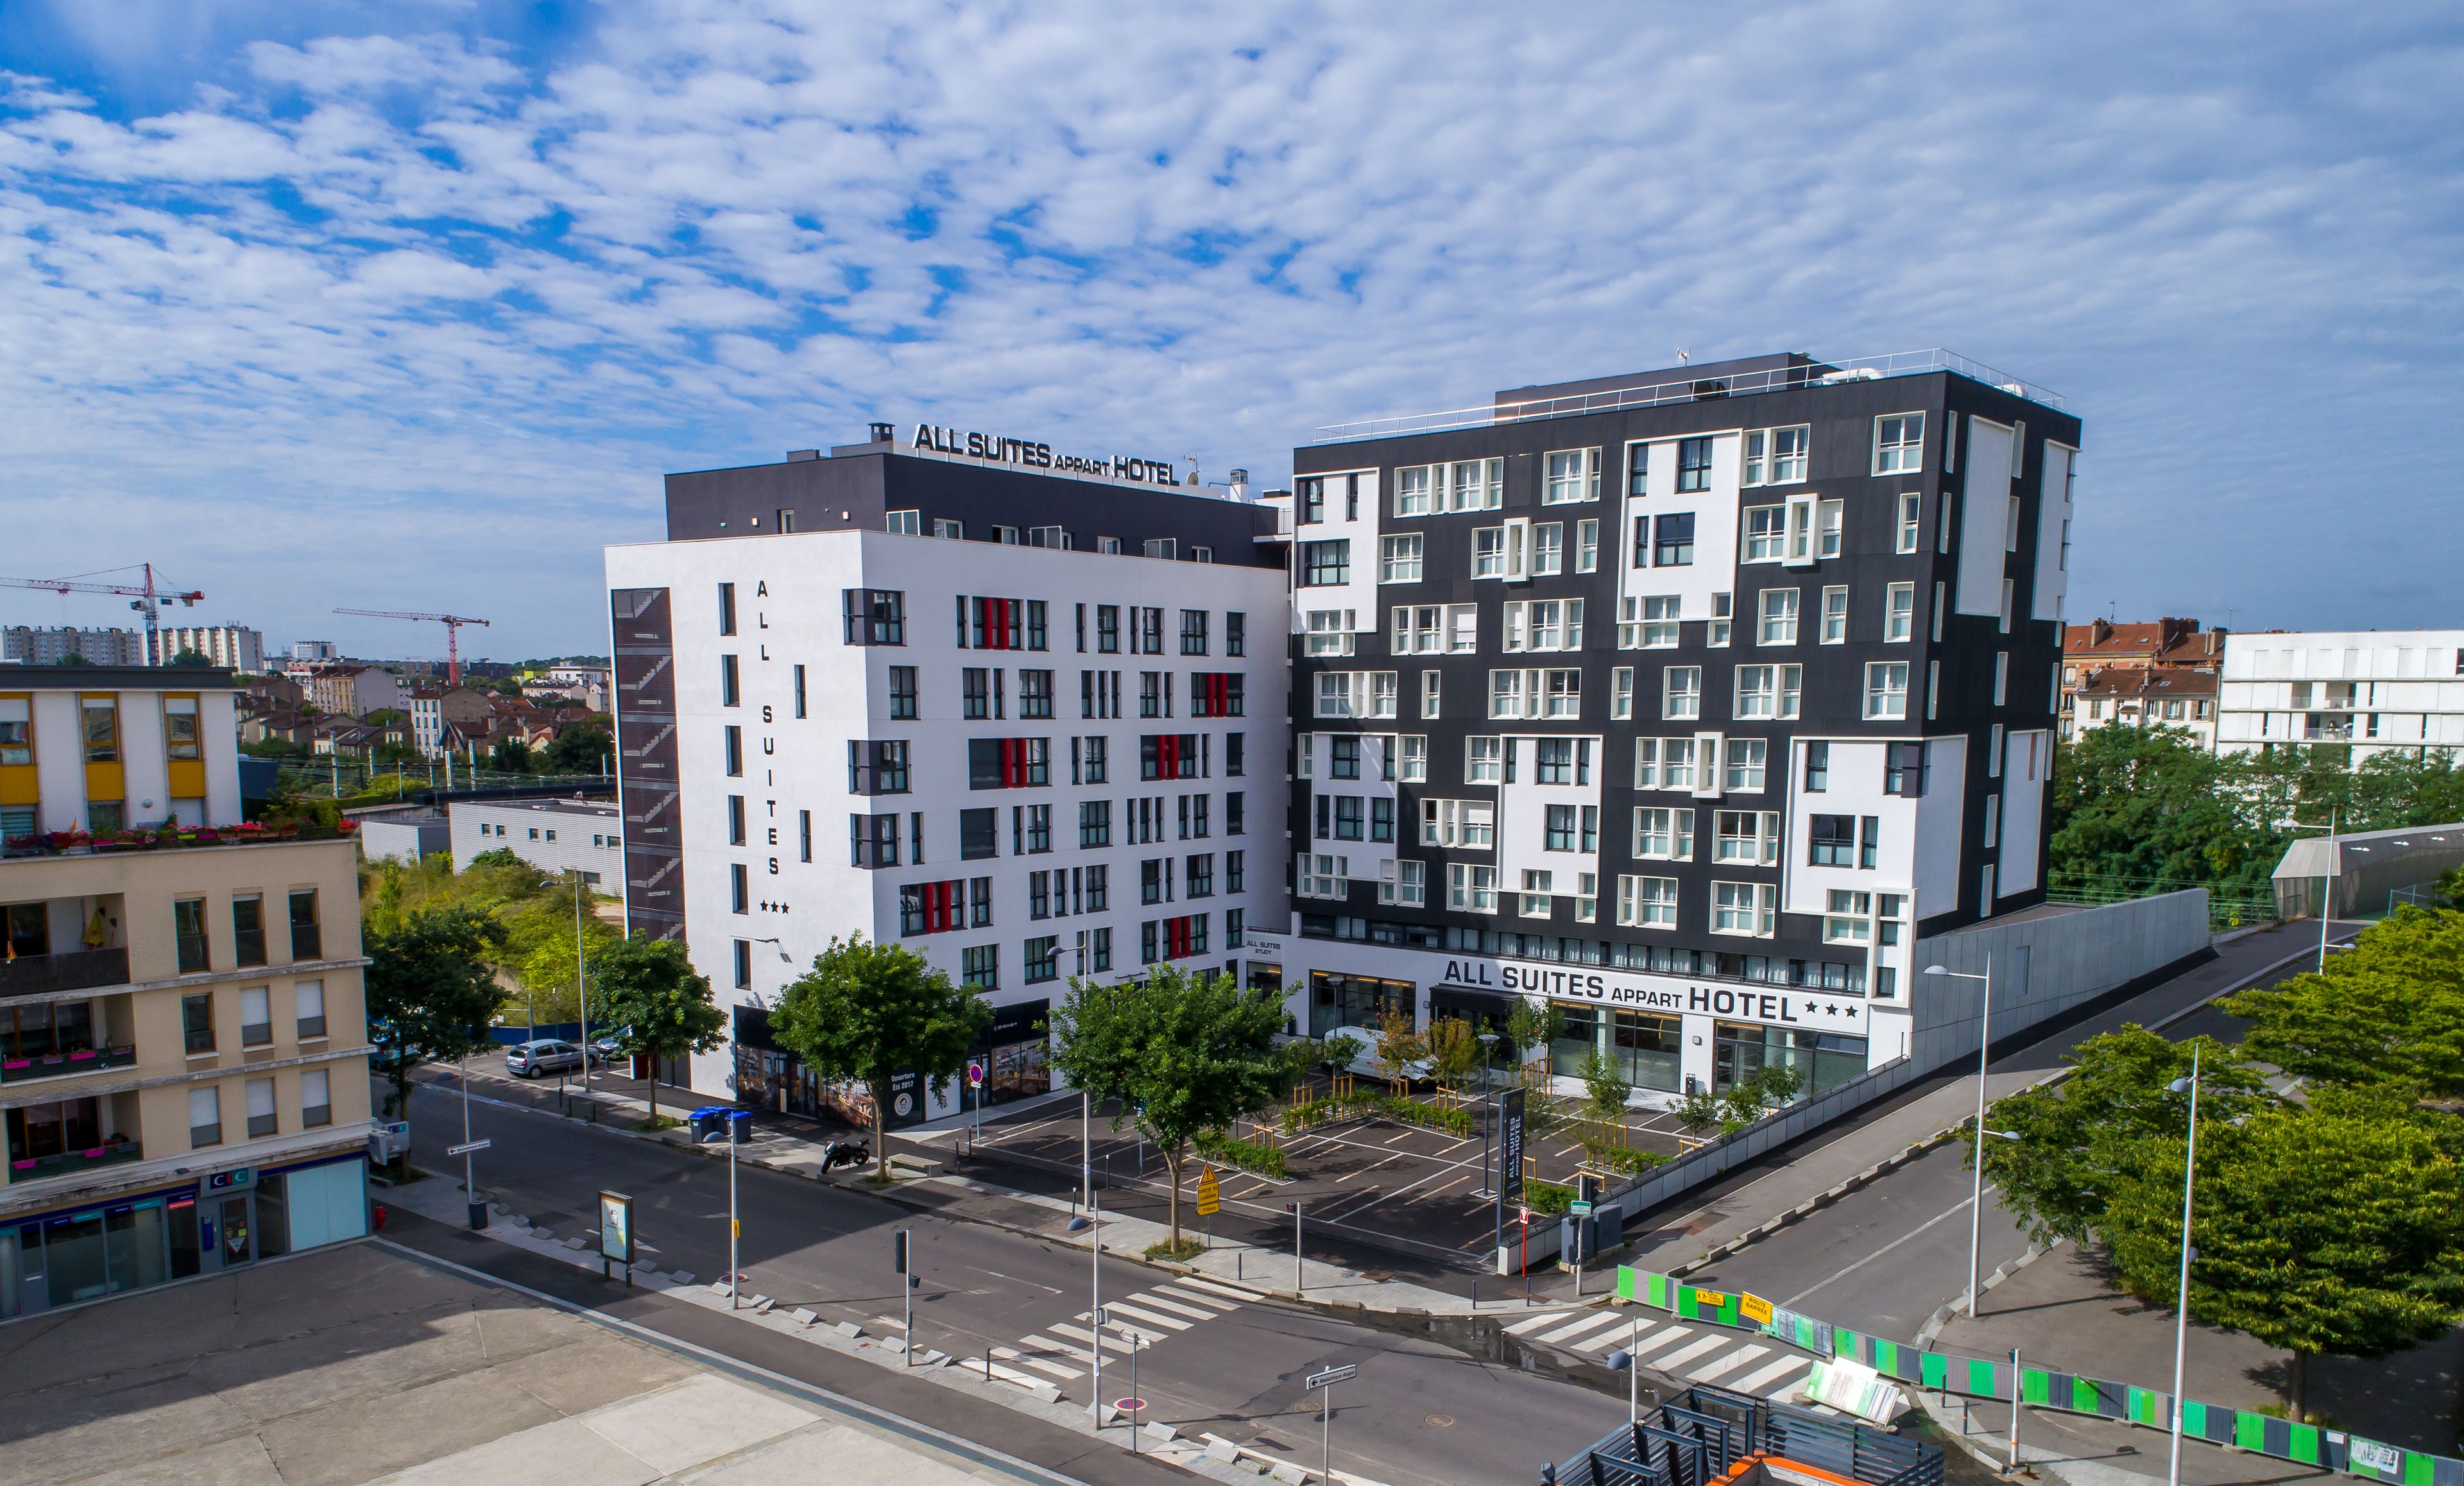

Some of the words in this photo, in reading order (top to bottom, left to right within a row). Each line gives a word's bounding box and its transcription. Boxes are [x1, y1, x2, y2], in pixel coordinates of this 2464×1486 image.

[914, 423, 963, 455] ALL
[967, 432, 1050, 468] SUITES
[1054, 455, 1110, 477] APPART
[1113, 456, 1179, 486] HOTEL
[757, 581, 769, 661] ALL
[763, 705, 778, 875] SUITES
[1260, 941, 1281, 950] SUITES
[1444, 960, 1492, 986] ALL
[1502, 966, 1604, 998] SUITES
[1611, 987, 1682, 1009] APPART
[1690, 986, 1798, 1023] HOTEL
[902, 1080, 914, 1089] 2017
[1749, 1297, 1766, 1308] ROUTE
